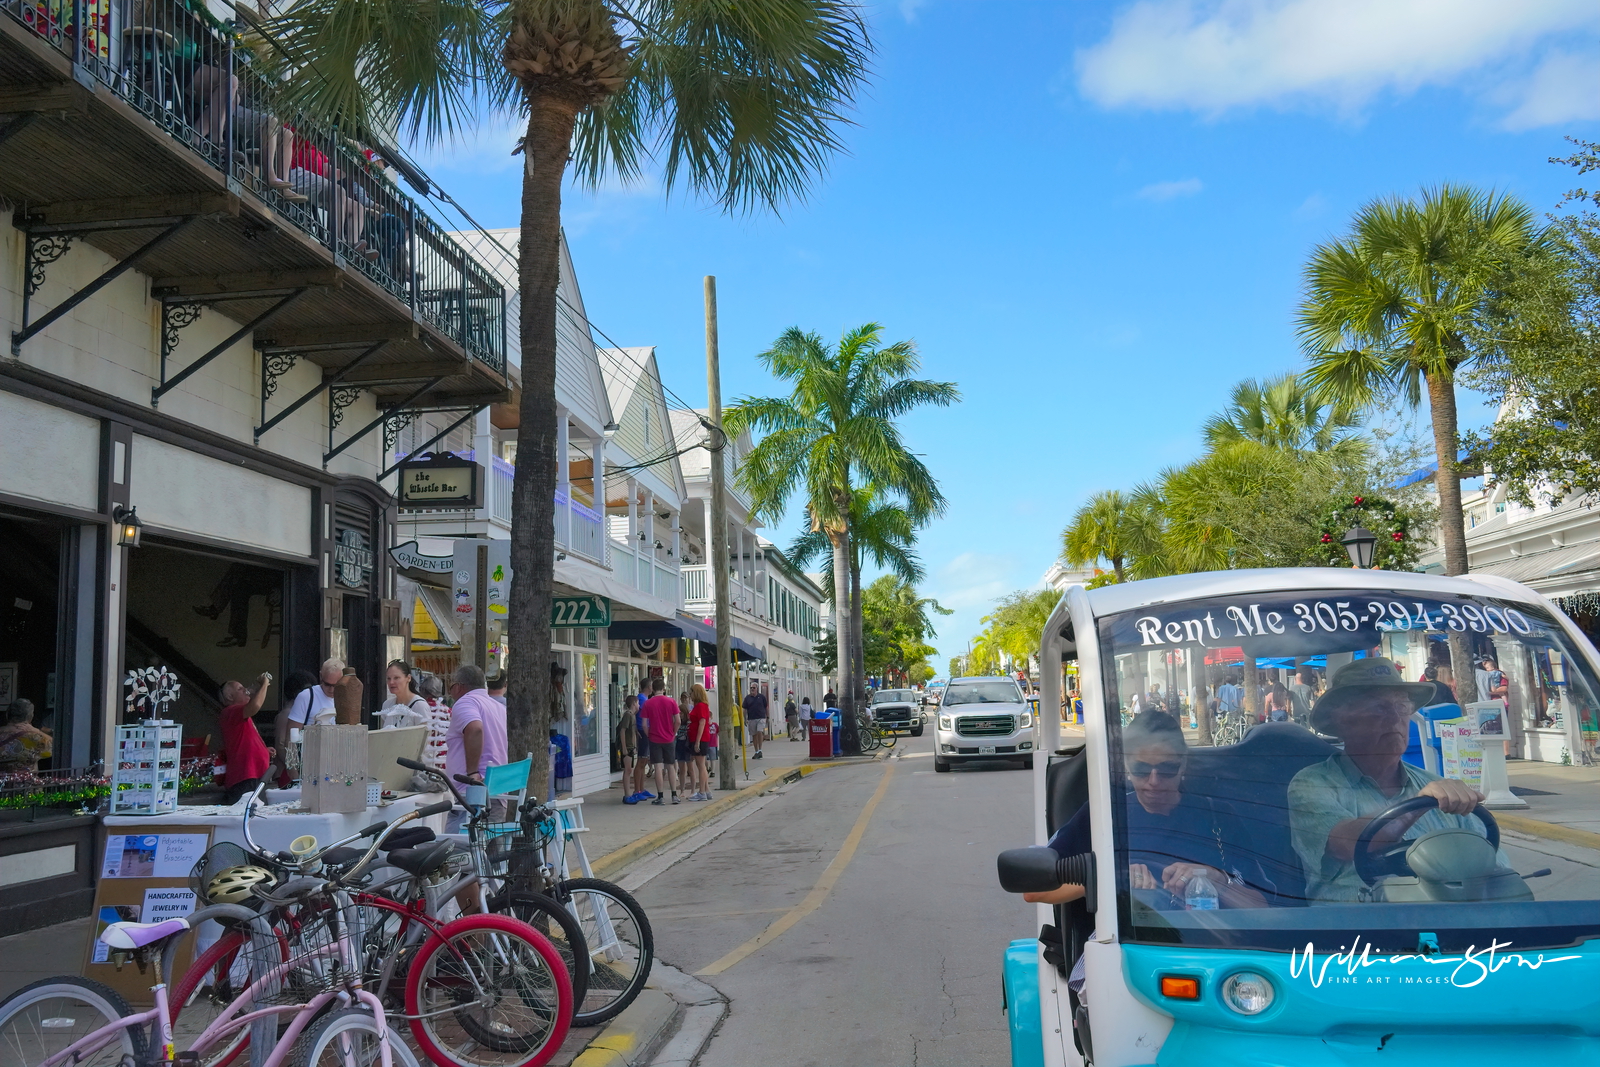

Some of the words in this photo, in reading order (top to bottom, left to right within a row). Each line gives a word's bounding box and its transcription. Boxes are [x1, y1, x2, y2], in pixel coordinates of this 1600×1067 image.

[415, 472, 430, 481] the
[410, 483, 439, 493] Whistle
[441, 484, 457, 492] Bar
[398, 552, 436, 569] GARDEN
[343, 563, 362, 582] BAR
[555, 600, 590, 625] 222
[1135, 611, 1221, 647] Rent
[1225, 604, 1286, 638] Me
[1293, 601, 1530, 635] 305-294-3900
[1459, 728, 1471, 737] Key
[161, 836, 193, 846] Adjustable
